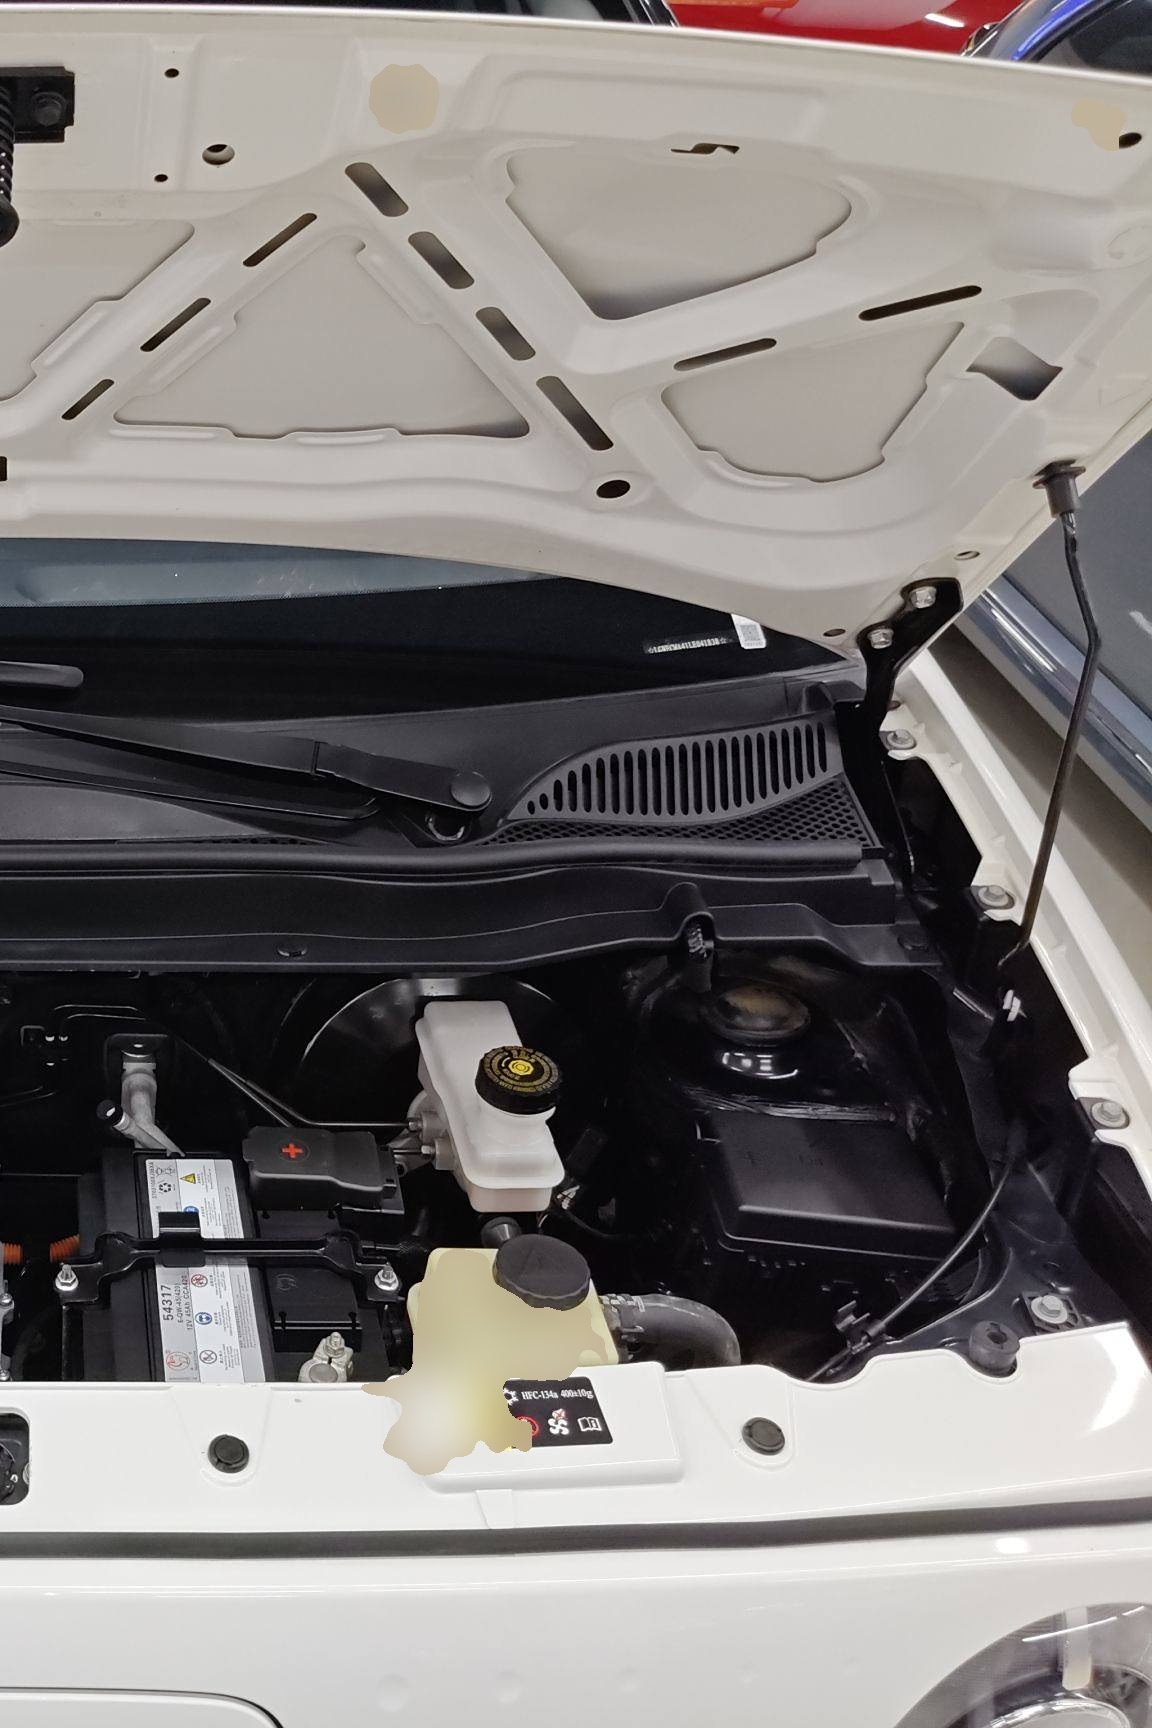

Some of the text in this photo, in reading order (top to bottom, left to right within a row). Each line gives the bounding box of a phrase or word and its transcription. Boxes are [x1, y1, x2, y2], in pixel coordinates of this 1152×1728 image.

[160, 1285, 174, 1321] 54317
[521, 1388, 594, 1400] HFC-134a 400±10g
